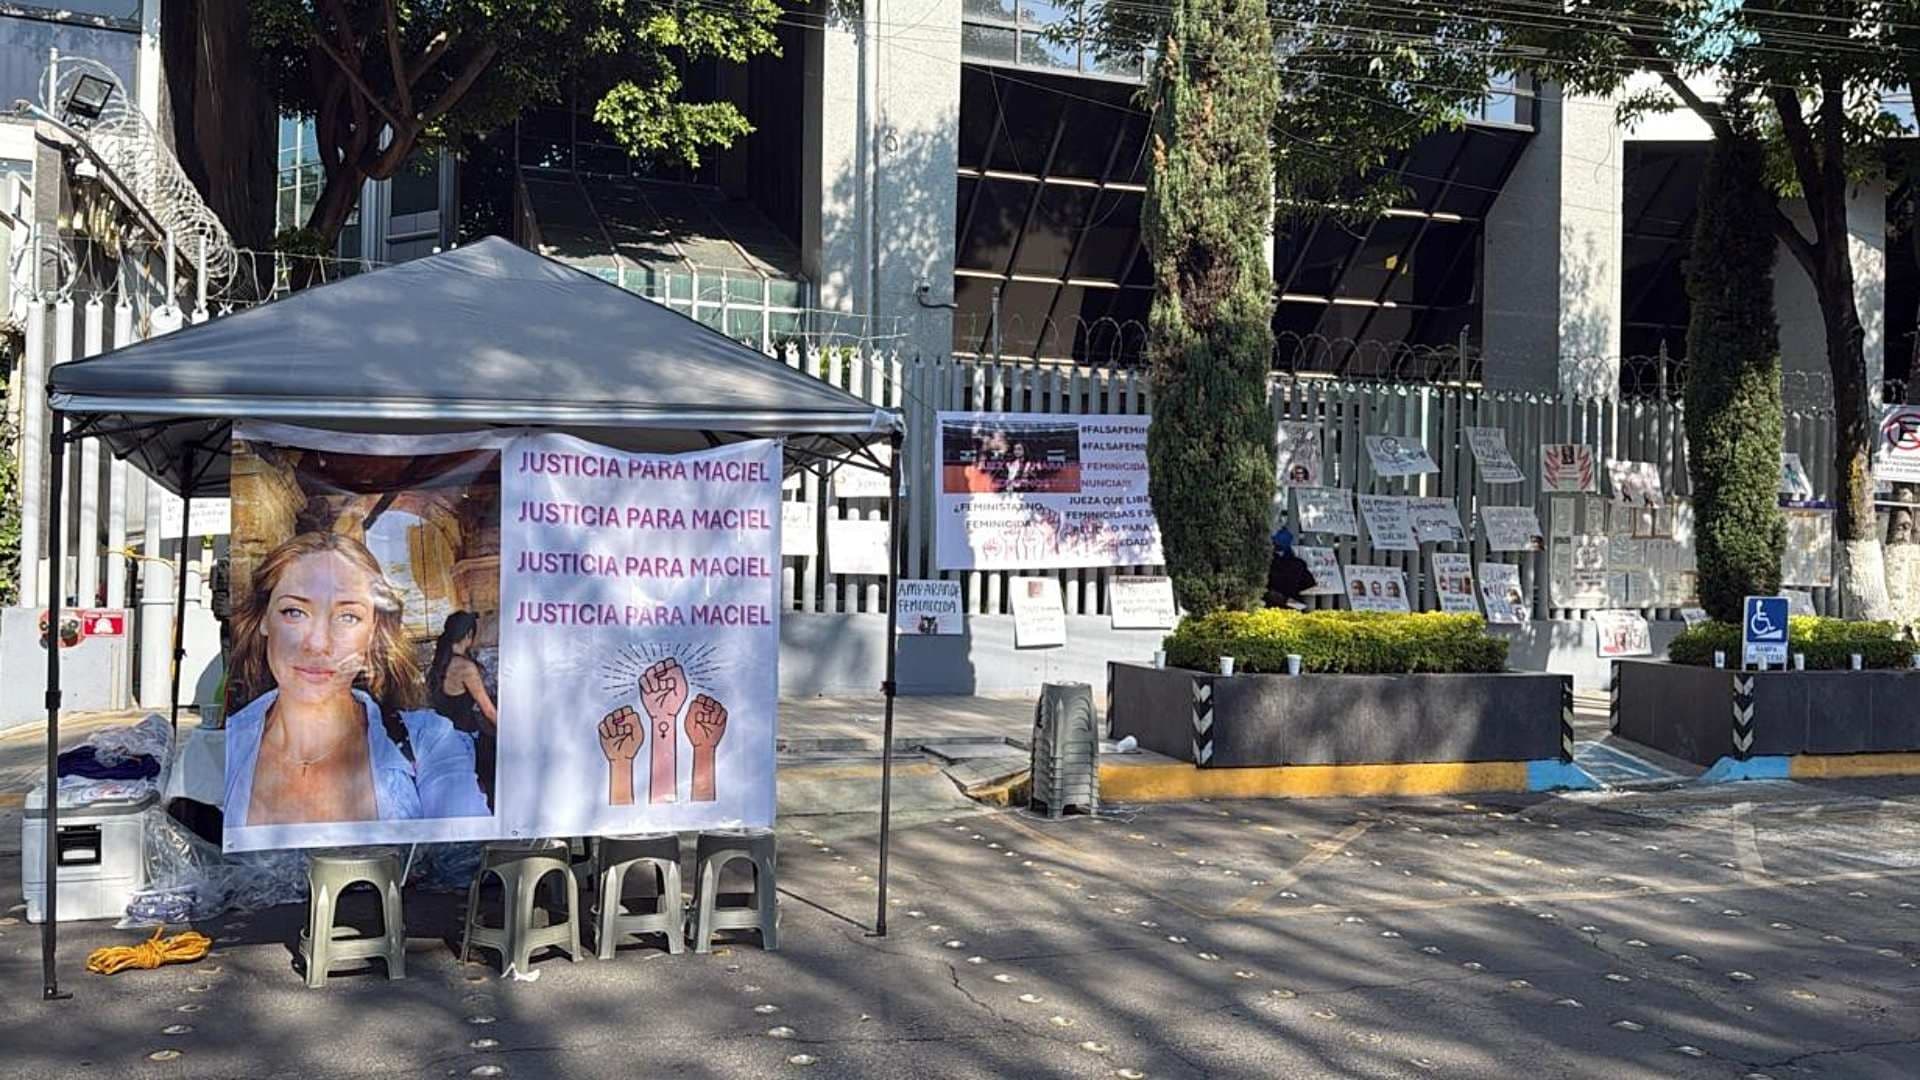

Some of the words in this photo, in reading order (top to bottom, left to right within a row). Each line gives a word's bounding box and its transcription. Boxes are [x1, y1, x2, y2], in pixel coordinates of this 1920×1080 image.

[519, 451, 621, 478] JUSTICIA
[628, 460, 687, 480] PARA
[693, 461, 770, 482] MACIEL
[1069, 496, 1101, 505] JUEZA
[518, 501, 620, 528] JUSTICIA
[626, 507, 686, 529] PARA
[692, 509, 770, 530] MACIEL
[517, 551, 619, 577] JUSTICIA
[625, 557, 684, 578] PARA
[690, 557, 771, 577] MACIEL
[516, 601, 618, 625] JUSTICIA
[625, 605, 686, 626] PARA
[691, 605, 771, 625] MACIEL
